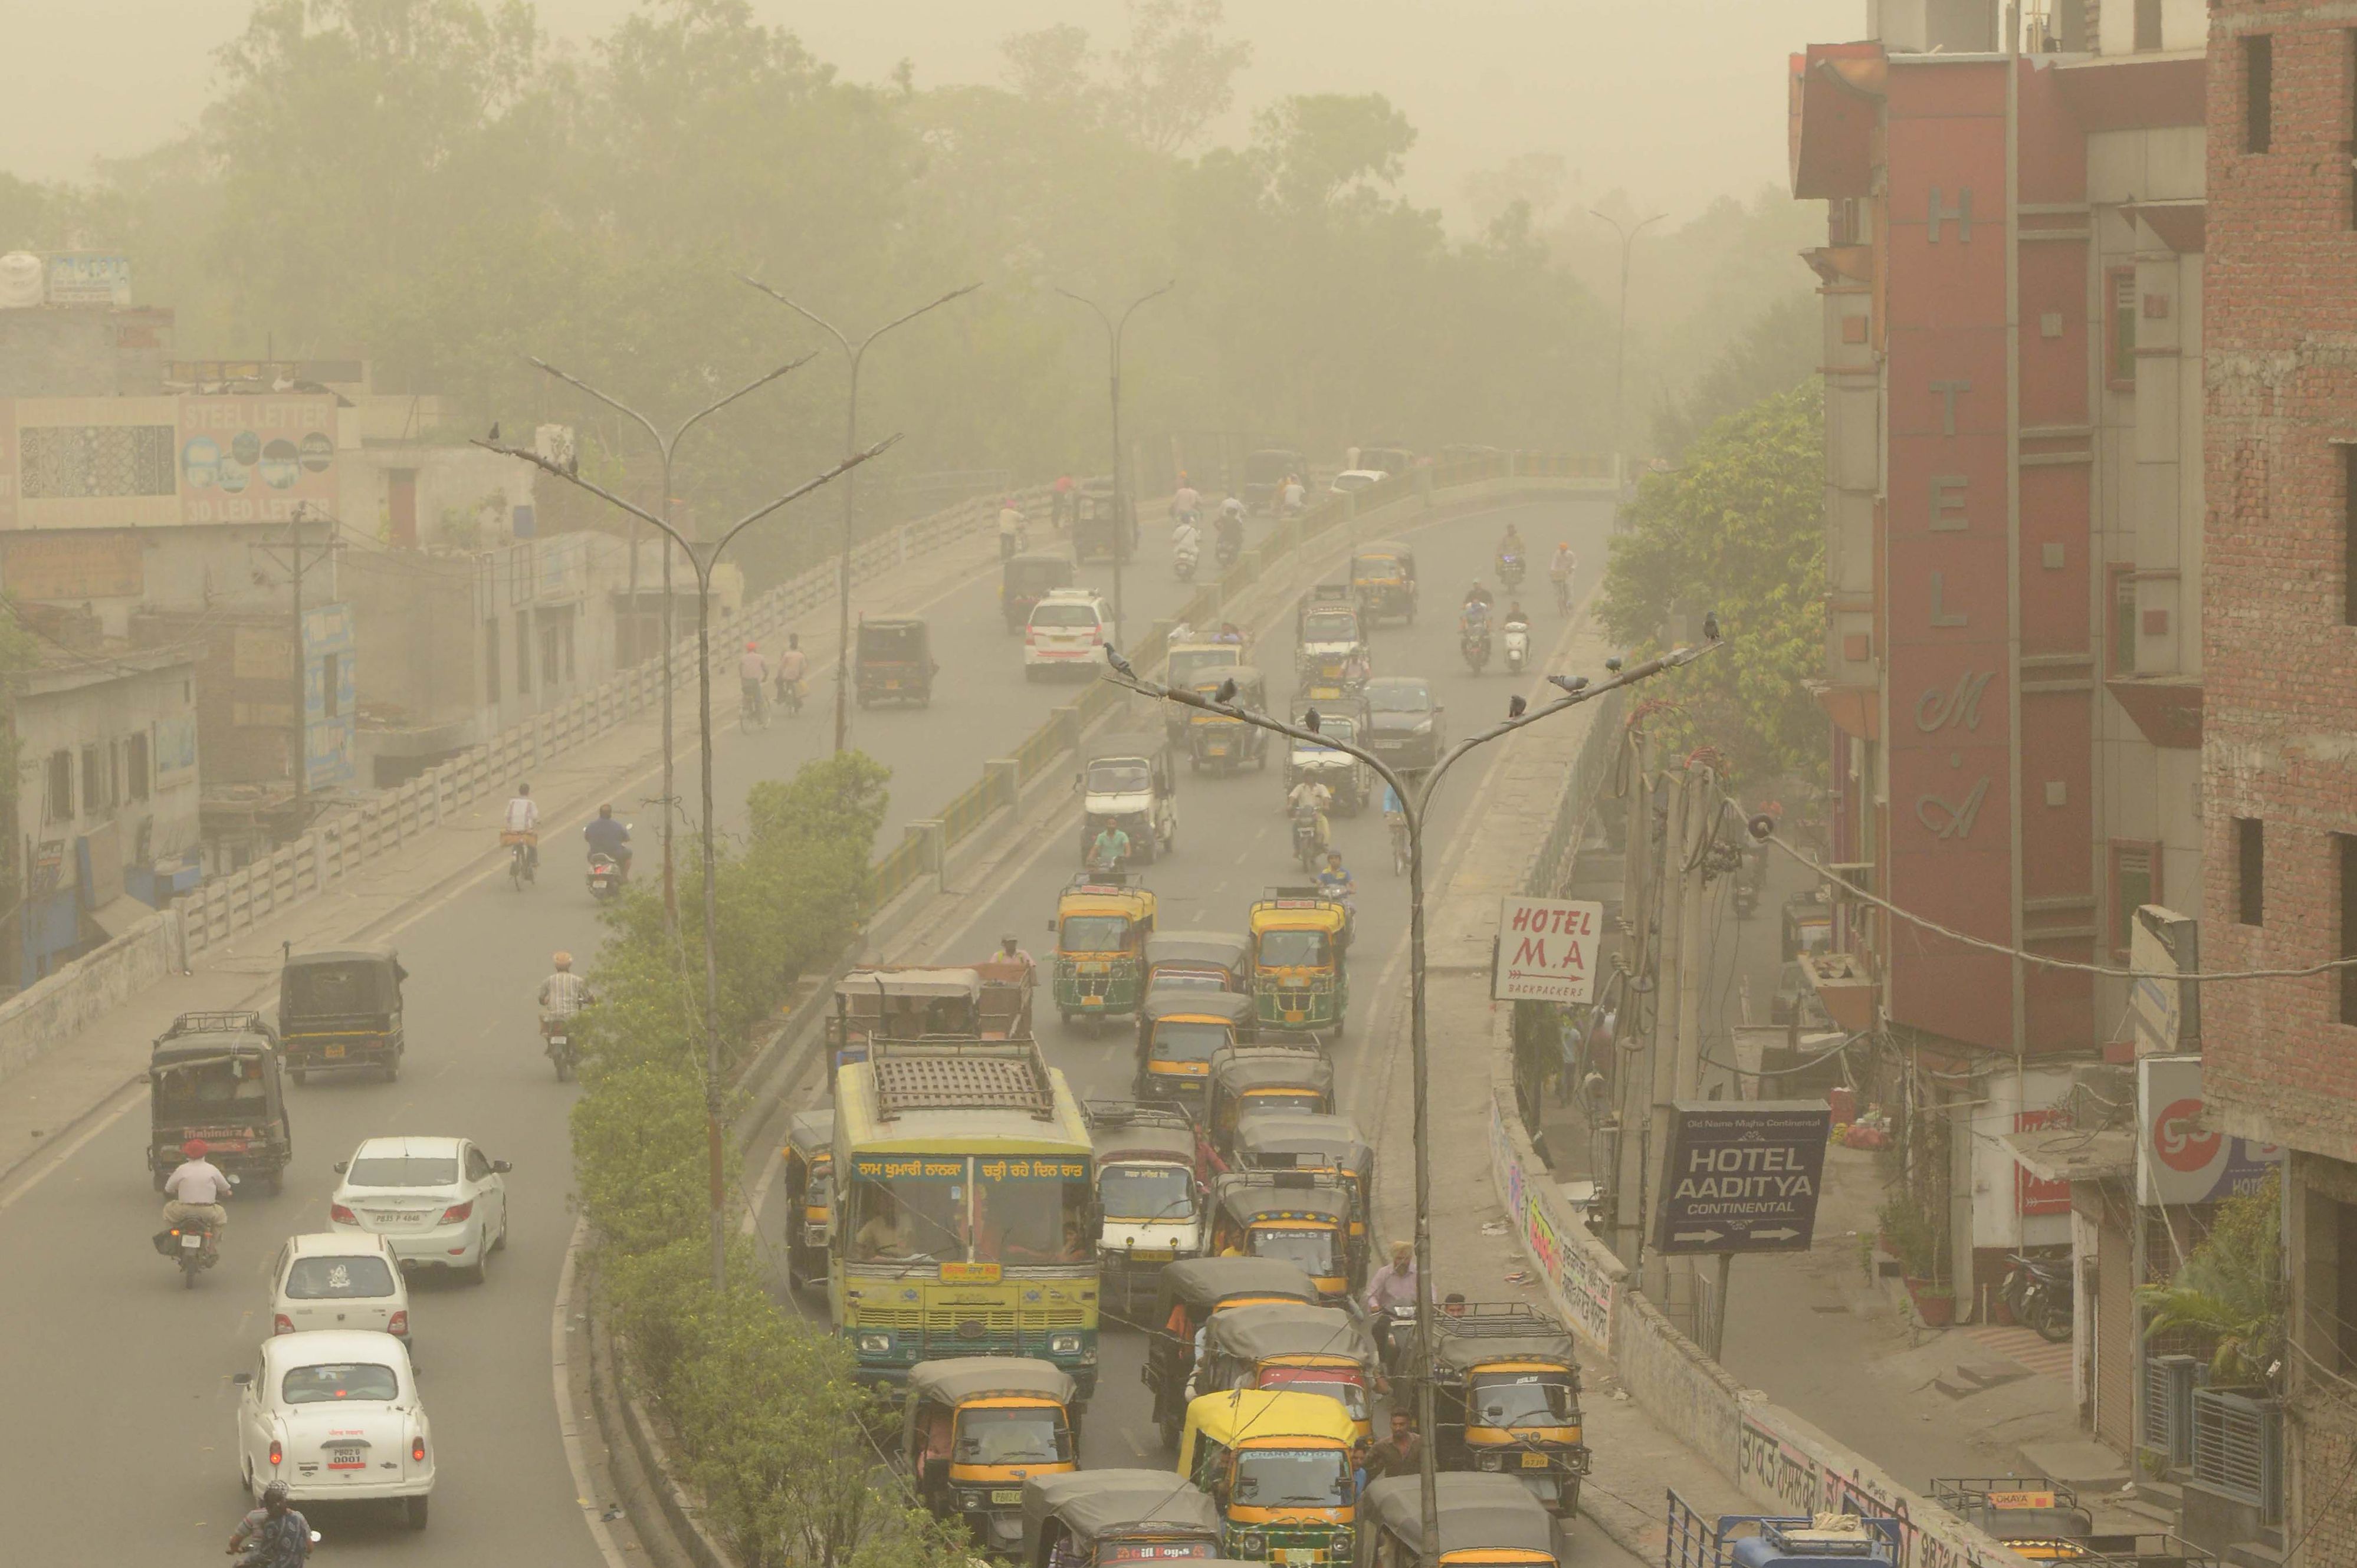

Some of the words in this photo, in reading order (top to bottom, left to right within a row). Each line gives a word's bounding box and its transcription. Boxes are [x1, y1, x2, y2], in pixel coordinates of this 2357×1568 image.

[185, 403, 246, 429] STEEL
[253, 402, 330, 428] LETTER
[188, 499, 211, 522] 3D
[217, 499, 254, 522] LED
[1512, 907, 1591, 936] HOTEL
[1512, 937, 1585, 970] M.A
[1508, 983, 1584, 998] BACKPACKERS
[183, 1127, 242, 1139] Mahindra
[1687, 1119, 1702, 1128] Old
[1704, 1119, 1733, 1128] Name
[1735, 1119, 1765, 1129] Majha
[1766, 1119, 1820, 1128] Continental
[1689, 1148, 1804, 1172] HOTEL
[1675, 1176, 1812, 1199] AADITYA
[1686, 1201, 1795, 1215] CONTINENTAL
